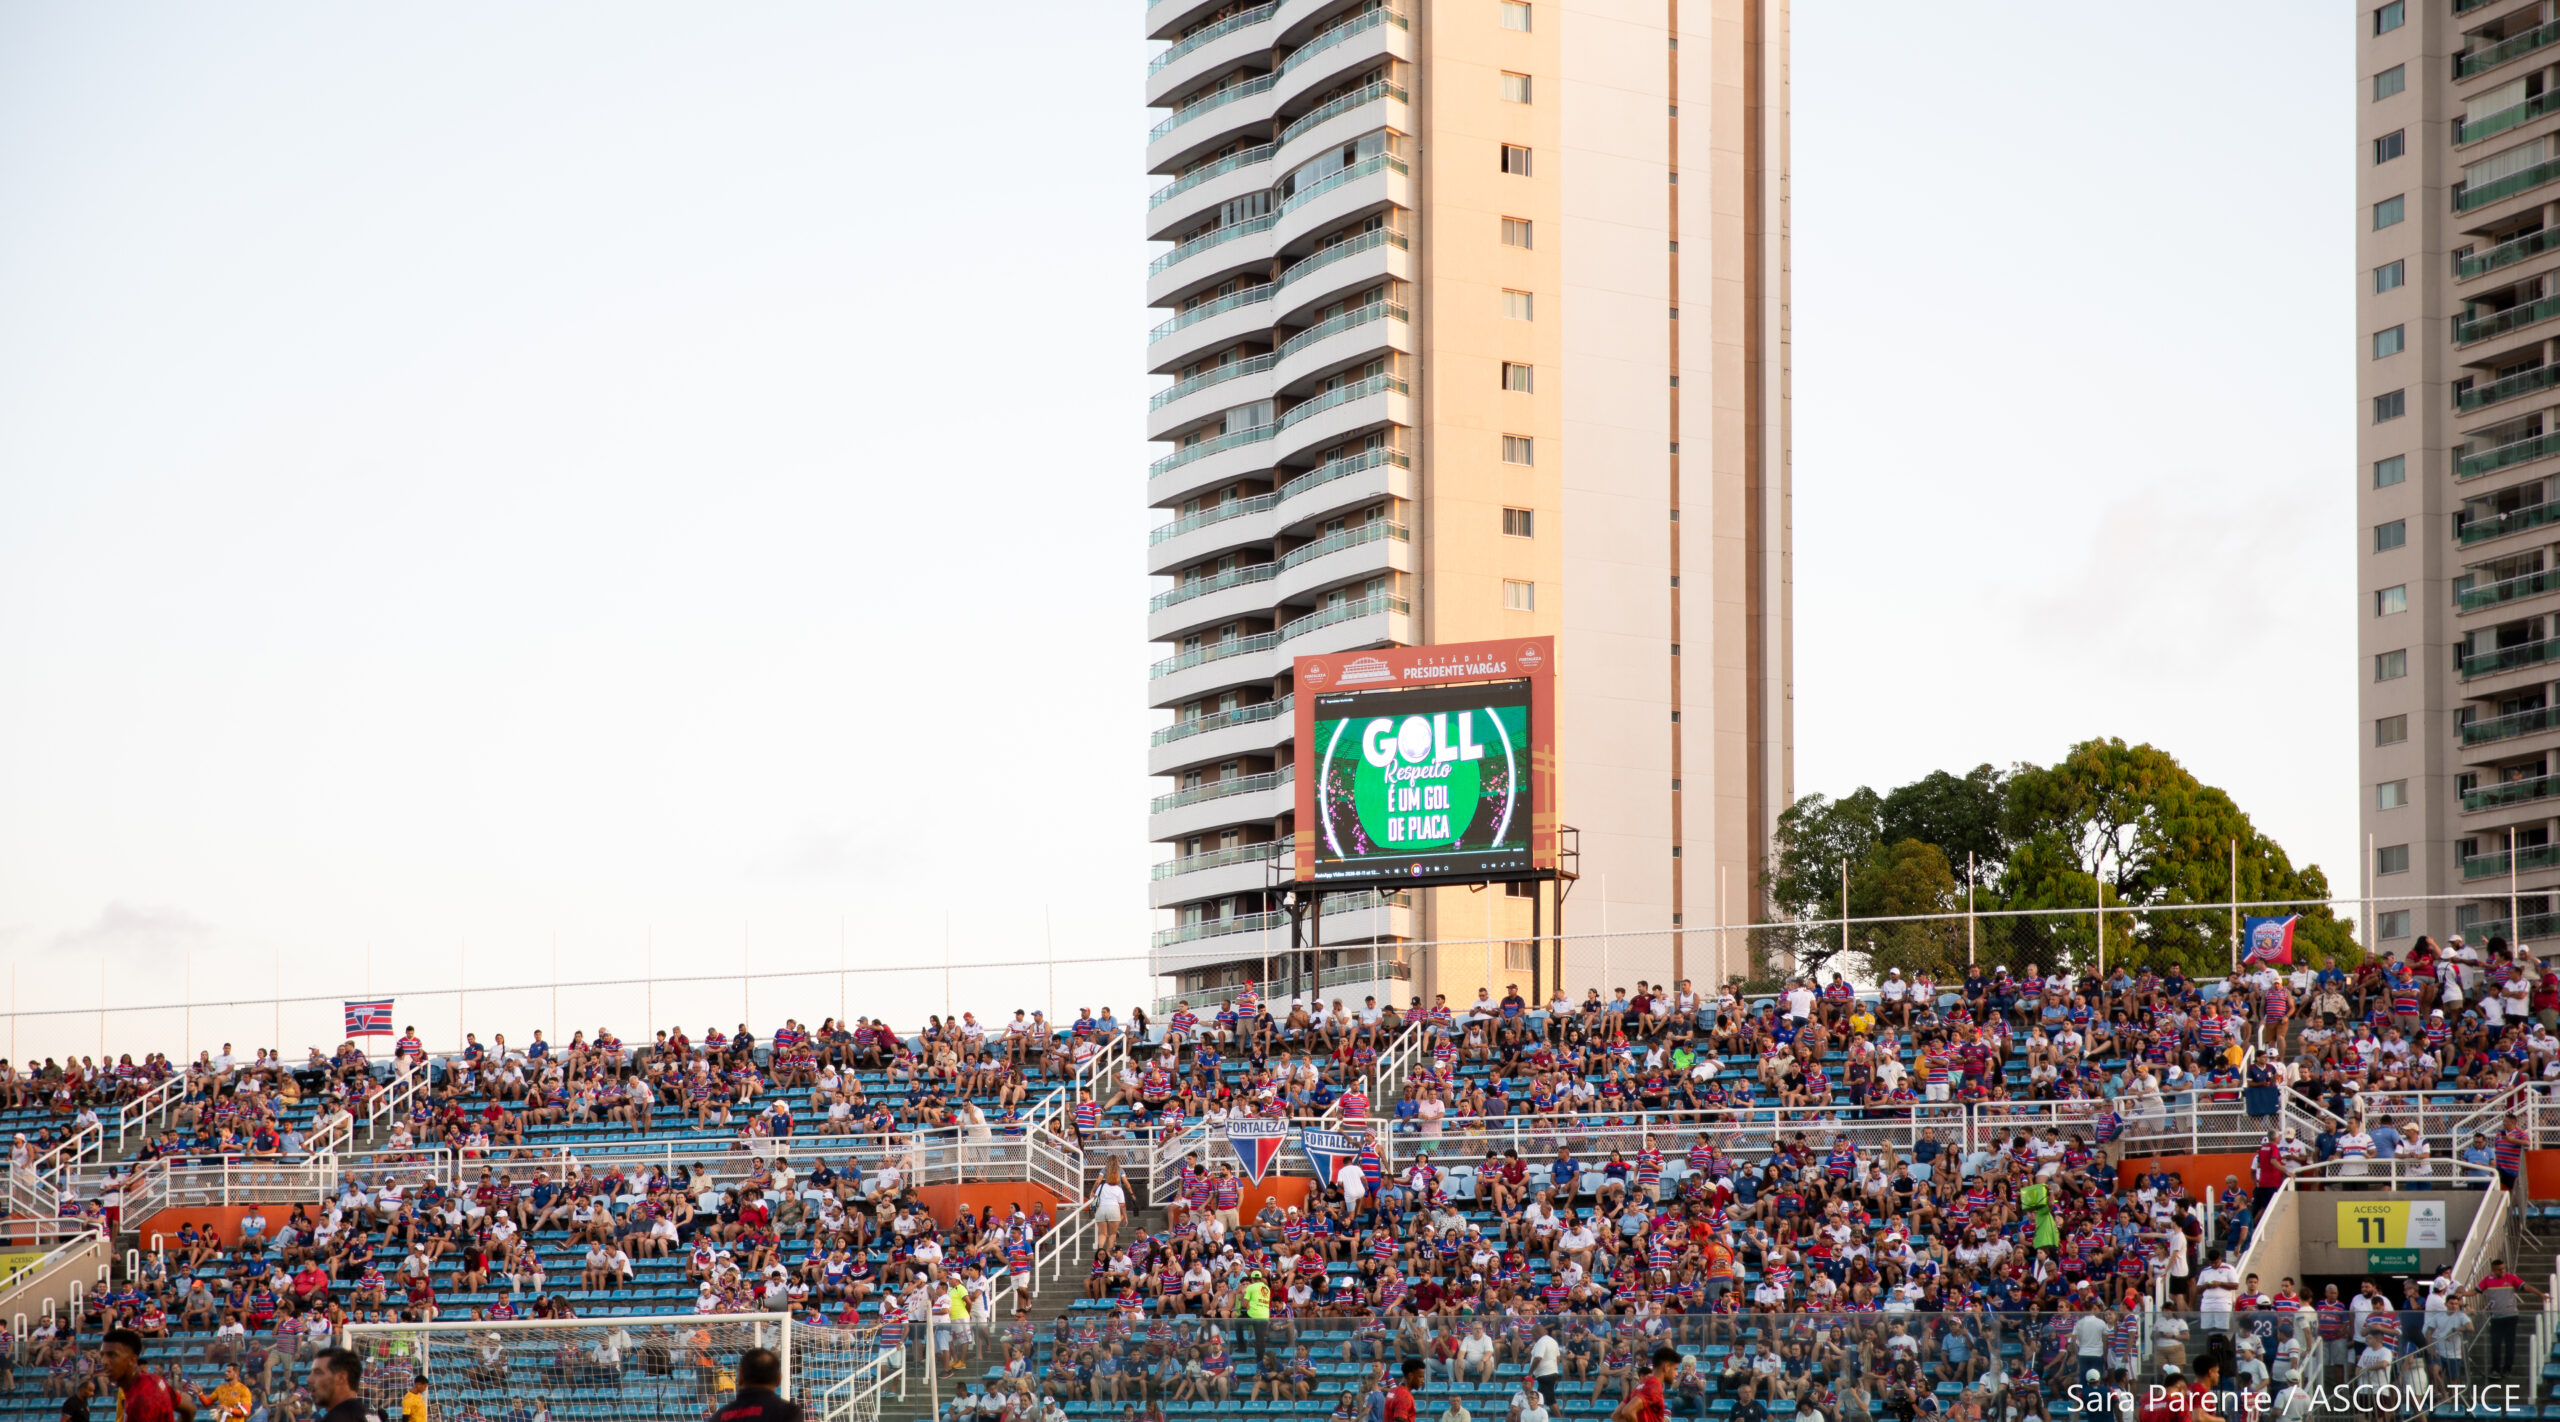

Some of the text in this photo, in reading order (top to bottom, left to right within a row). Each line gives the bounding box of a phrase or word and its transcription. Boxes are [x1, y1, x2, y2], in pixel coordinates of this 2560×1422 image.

[1403, 664, 1464, 679] PRESIDENTE
[1465, 661, 1507, 675] VARGAS
[1384, 757, 1452, 788] Respeito
[1388, 783, 1450, 813] É UM GOL
[1388, 814, 1450, 842] DE PLACA
[1226, 1121, 1287, 1133] FORTALEZA
[2353, 1206, 2391, 1214] ACESSO
[2357, 1217, 2385, 1244] 11
[2254, 1320, 2272, 1337] 23
